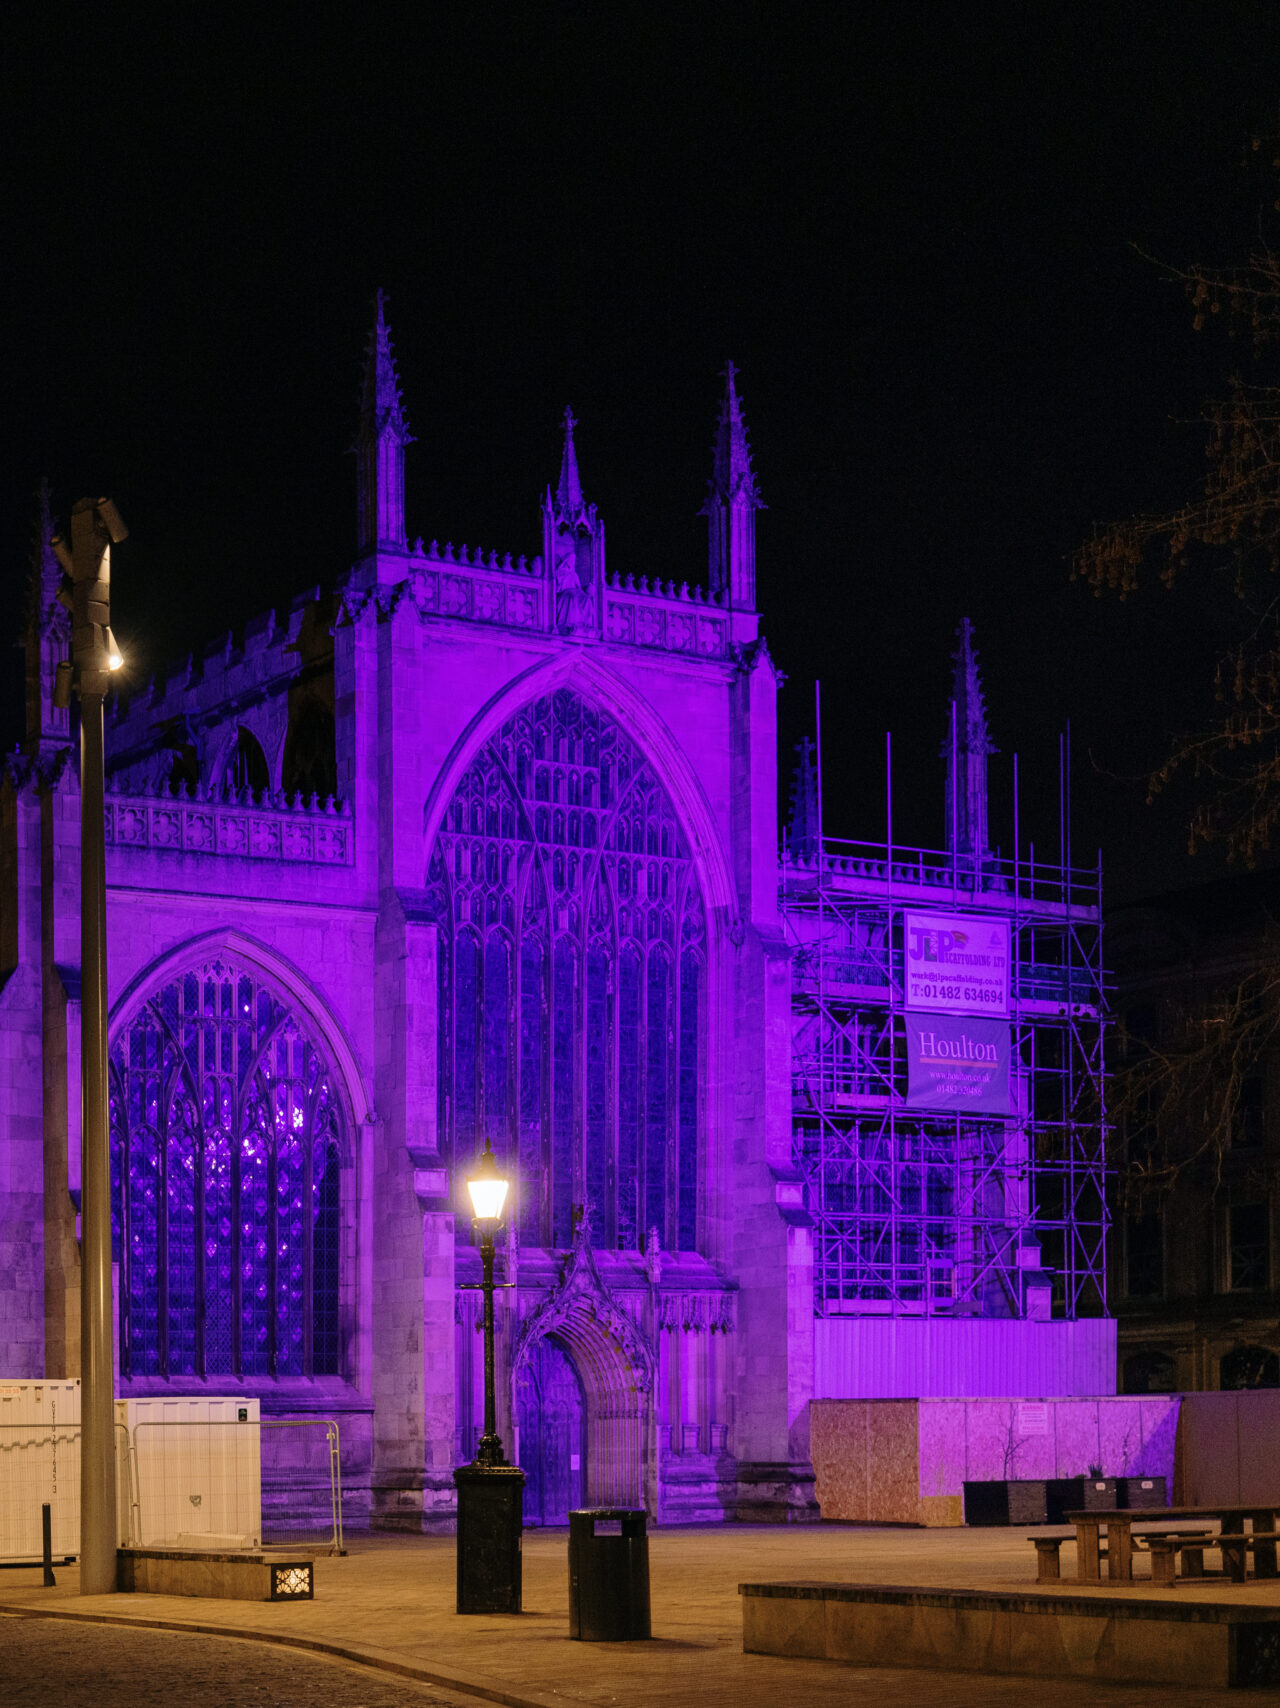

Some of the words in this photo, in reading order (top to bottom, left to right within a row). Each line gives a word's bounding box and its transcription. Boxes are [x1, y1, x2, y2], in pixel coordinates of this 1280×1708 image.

[944, 952, 991, 968] SCAFFOLDING
[993, 956, 1005, 968] LTD
[964, 987, 1003, 1004] 634694
[918, 1032, 999, 1061] Houlton
